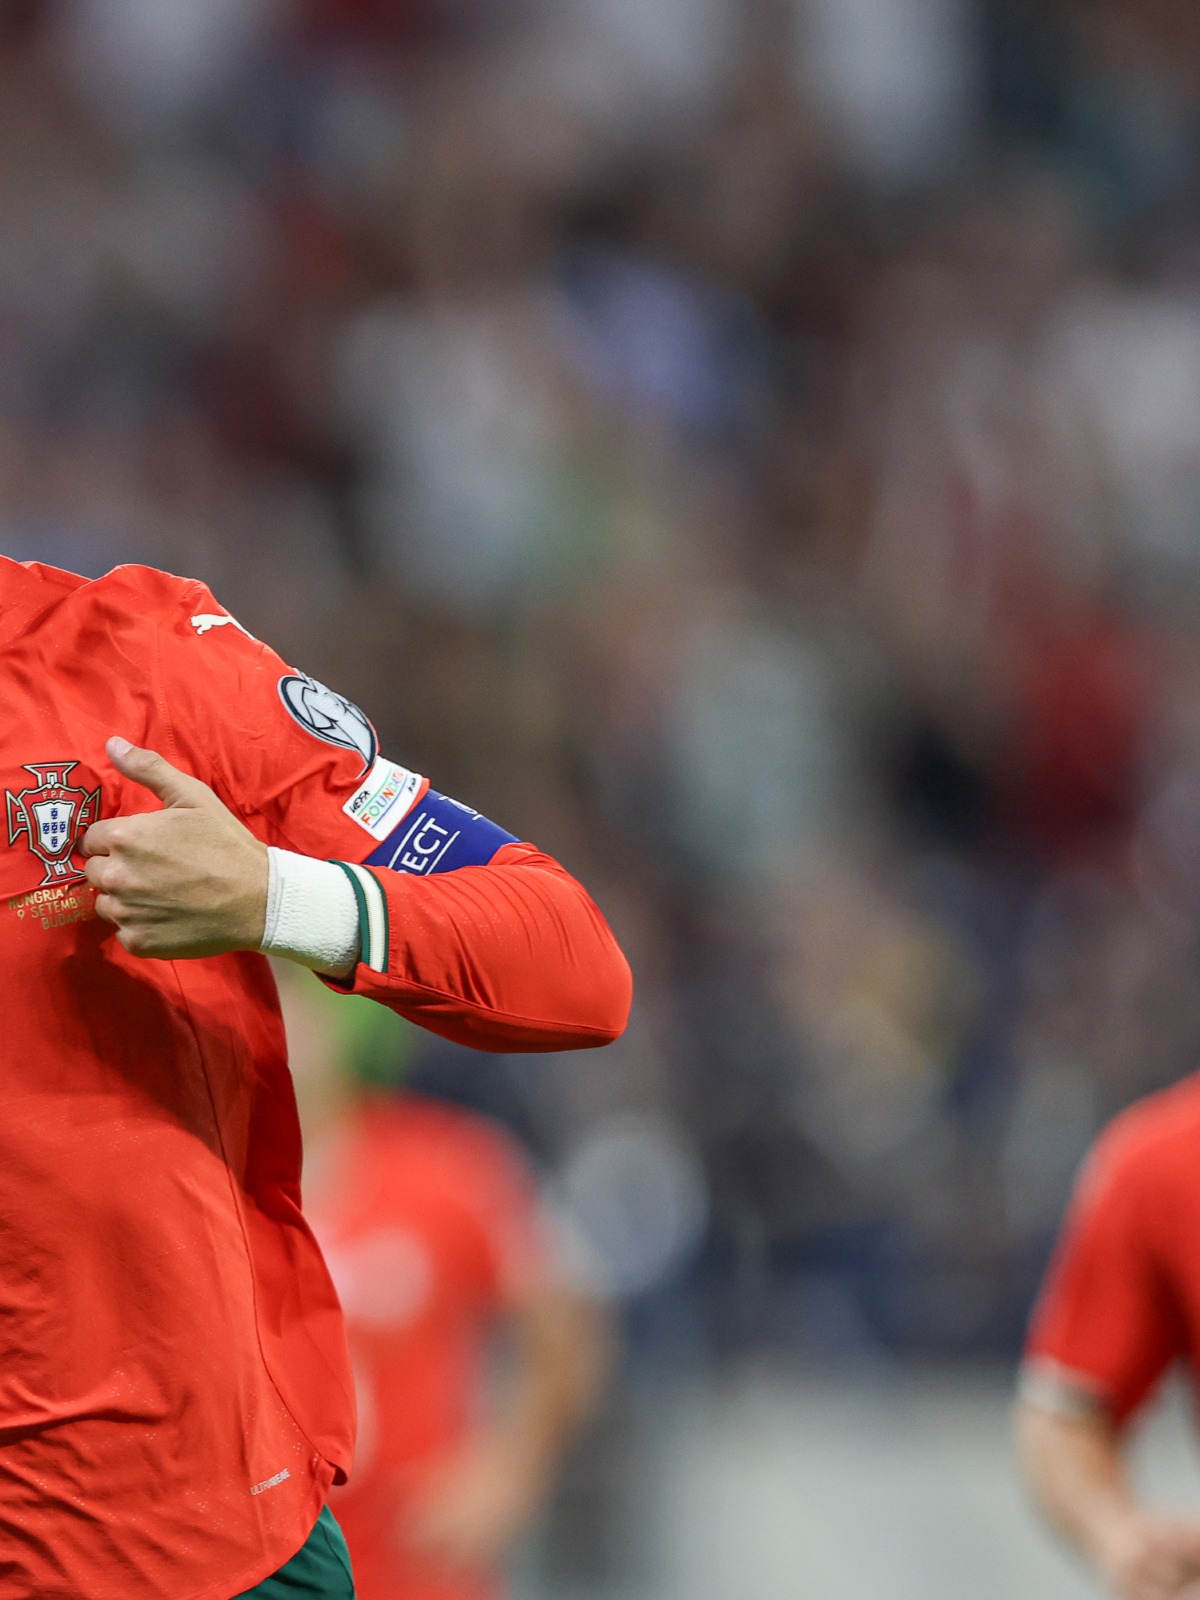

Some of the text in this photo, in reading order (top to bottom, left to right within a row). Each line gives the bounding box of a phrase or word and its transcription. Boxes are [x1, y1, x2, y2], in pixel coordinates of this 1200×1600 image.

[349, 790, 371, 814] UEFA
[397, 817, 449, 874] ECT
[17, 909, 25, 920] 9
